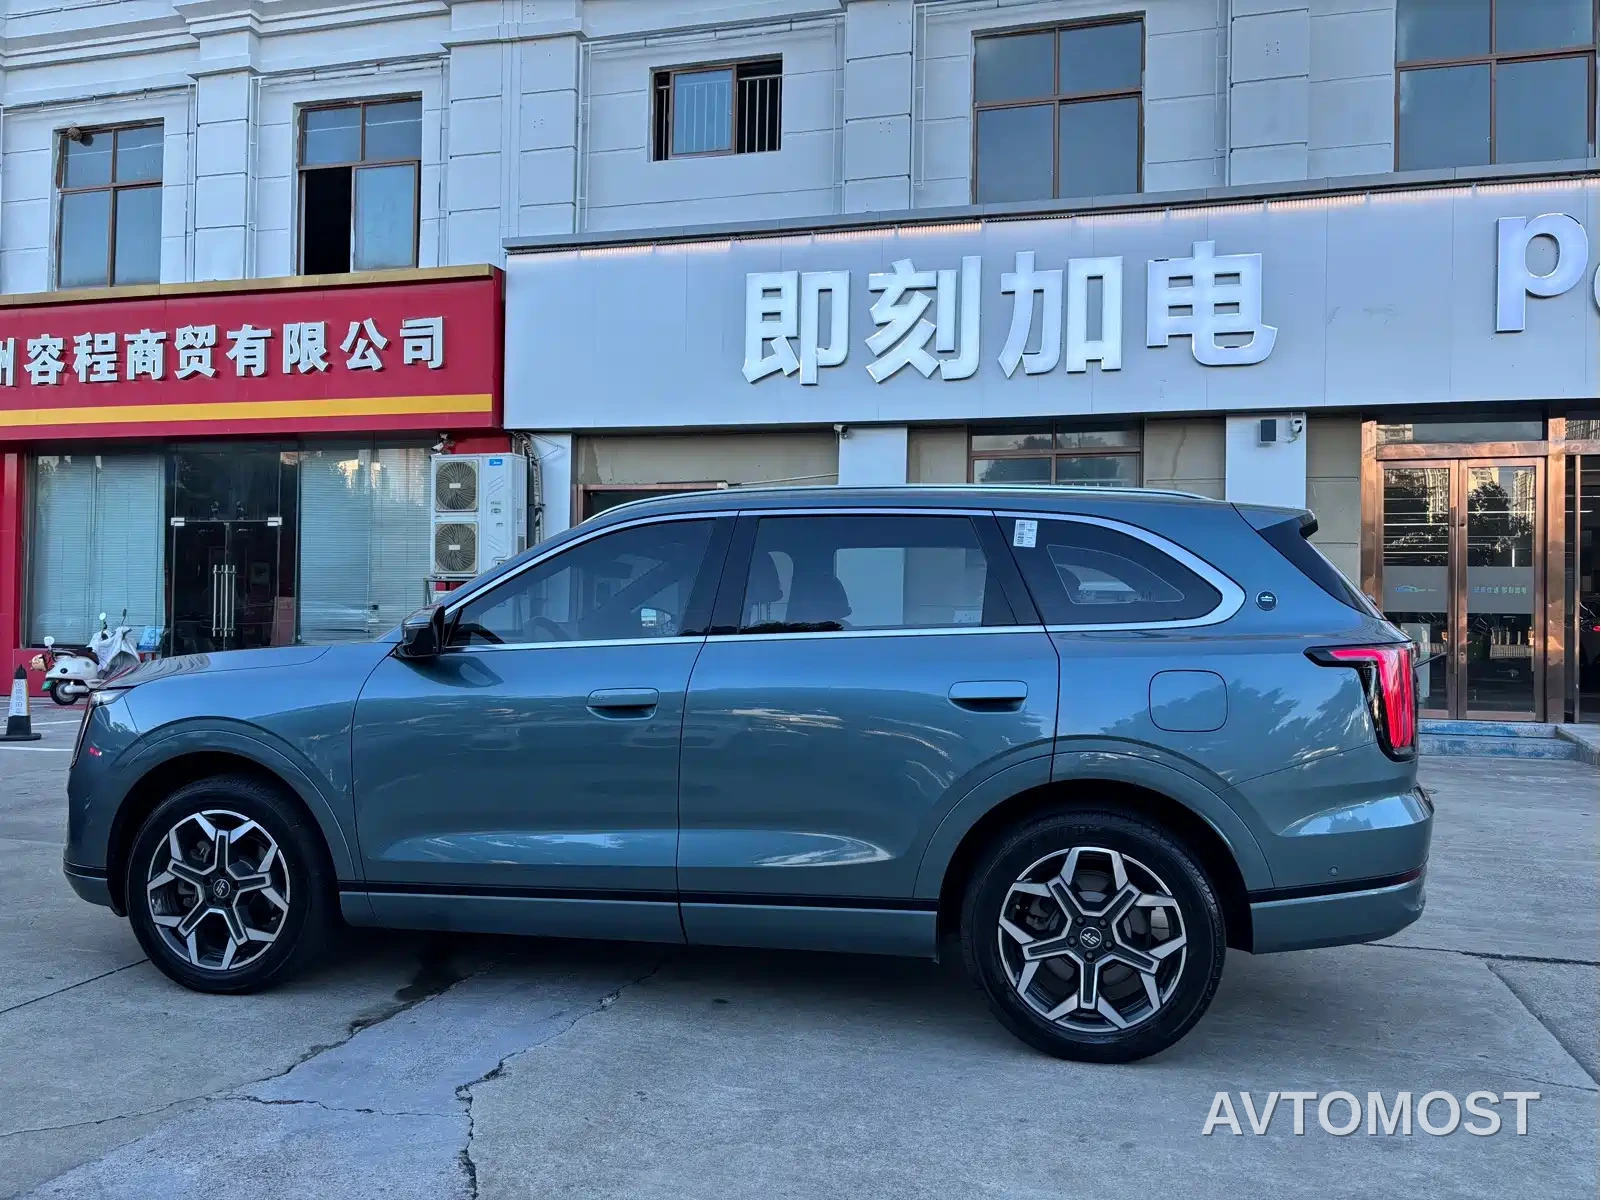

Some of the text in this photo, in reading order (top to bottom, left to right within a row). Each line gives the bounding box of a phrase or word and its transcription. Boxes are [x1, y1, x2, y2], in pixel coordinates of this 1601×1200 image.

[741, 240, 1279, 387] 即刻加电
[1495, 211, 1600, 333] p
